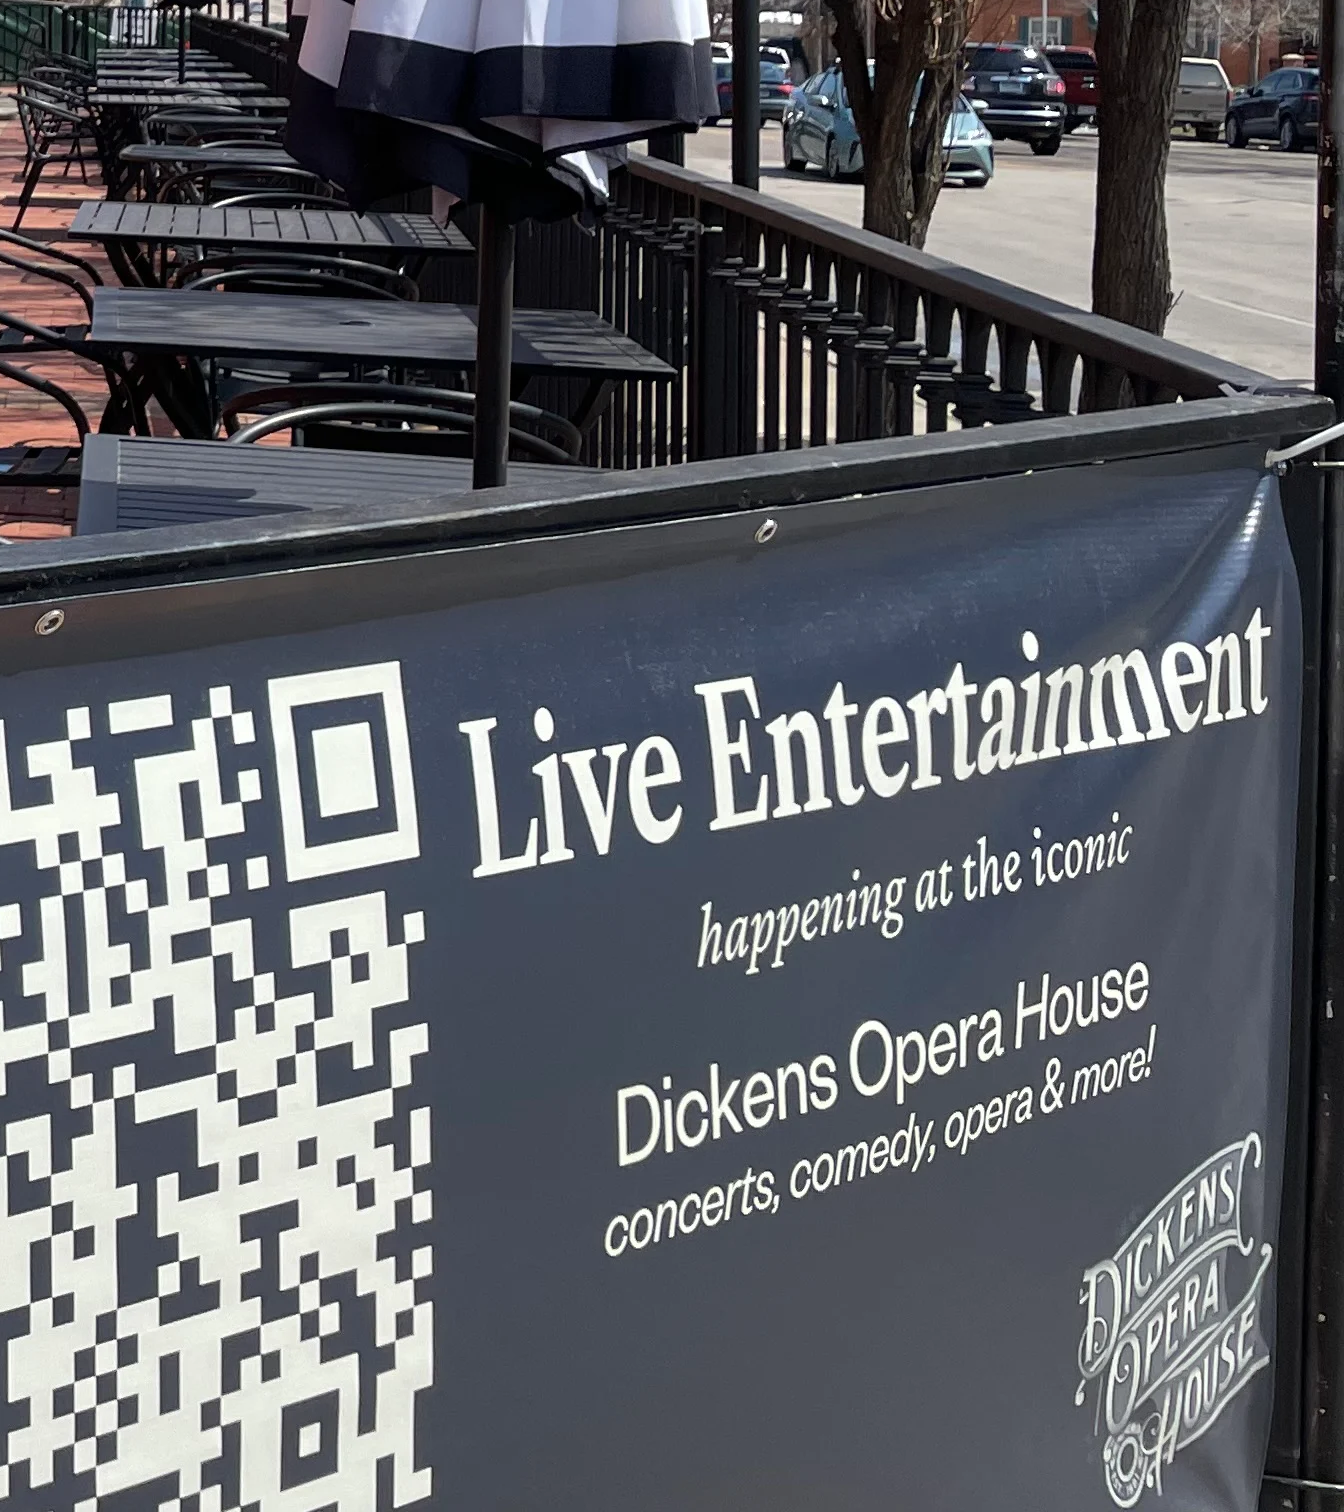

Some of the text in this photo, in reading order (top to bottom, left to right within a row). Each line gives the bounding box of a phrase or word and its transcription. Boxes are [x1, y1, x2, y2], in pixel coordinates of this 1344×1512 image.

[458, 607, 1273, 879] Live Entertainment
[697, 811, 1135, 976] happening at the iconic
[603, 1024, 1158, 1258] concerts, comedy, opera & more!
[616, 961, 1151, 1168] Dickens Opera House
[1078, 1160, 1236, 1380] DICKENS
[1106, 1259, 1220, 1433] OPERA
[1141, 1300, 1257, 1496] HOUSE
